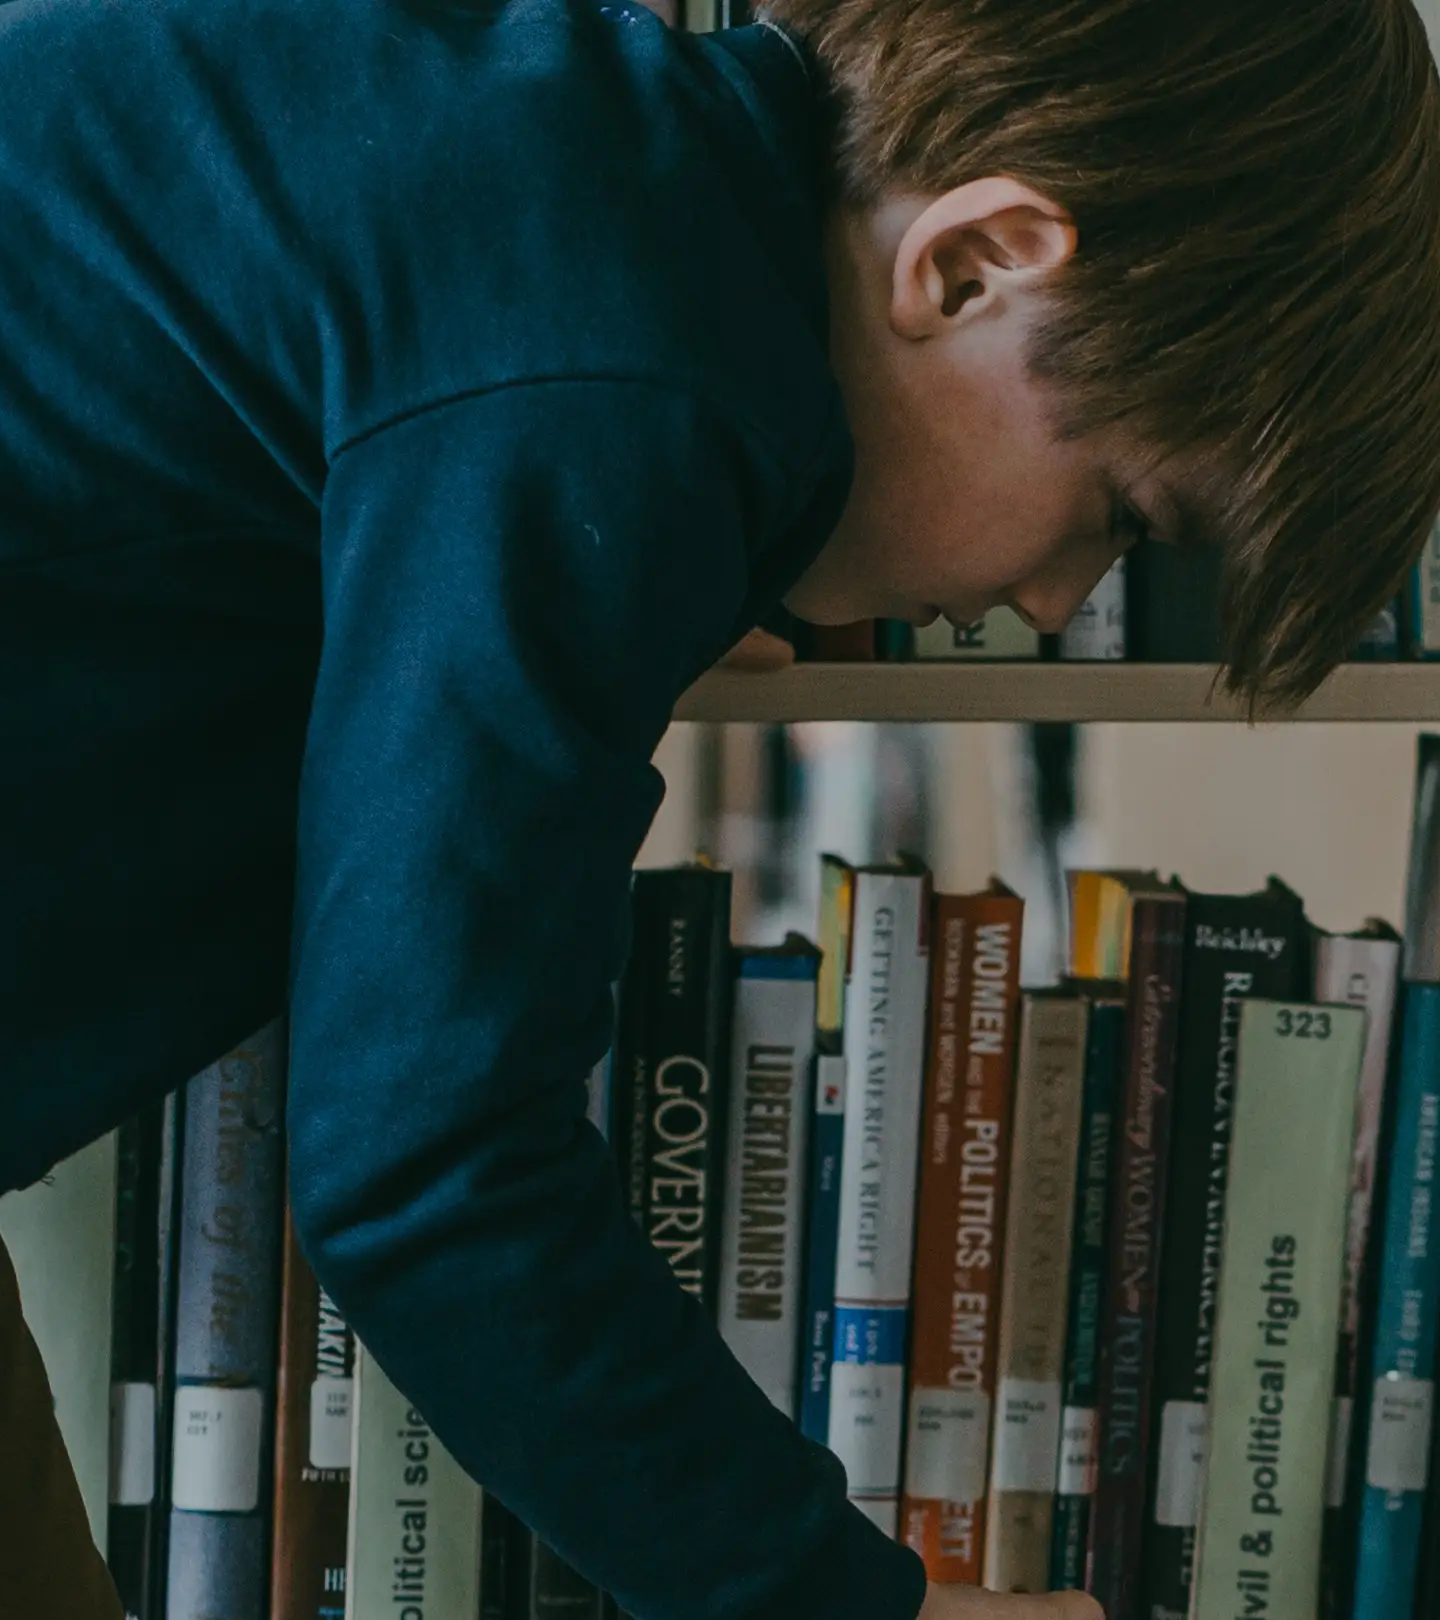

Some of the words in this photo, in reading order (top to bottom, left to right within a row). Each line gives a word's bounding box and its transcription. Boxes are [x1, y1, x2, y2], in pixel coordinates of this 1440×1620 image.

[868, 905, 896, 1036] GETTING
[966, 922, 1012, 1054] WOMEN
[1276, 1010, 1333, 1040] 323
[861, 1045, 888, 1173] AMERICA
[734, 1044, 796, 1323] LIBERTARIANISM
[856, 1181, 883, 1277] RIGHT
[955, 1117, 1000, 1269] POLITICS
[1121, 1150, 1158, 1285] WOMEN
[1257, 1235, 1301, 1347] rights
[1105, 1311, 1144, 1476] POLITICS
[1244, 1360, 1286, 1515] political
[1239, 1531, 1274, 1556] &
